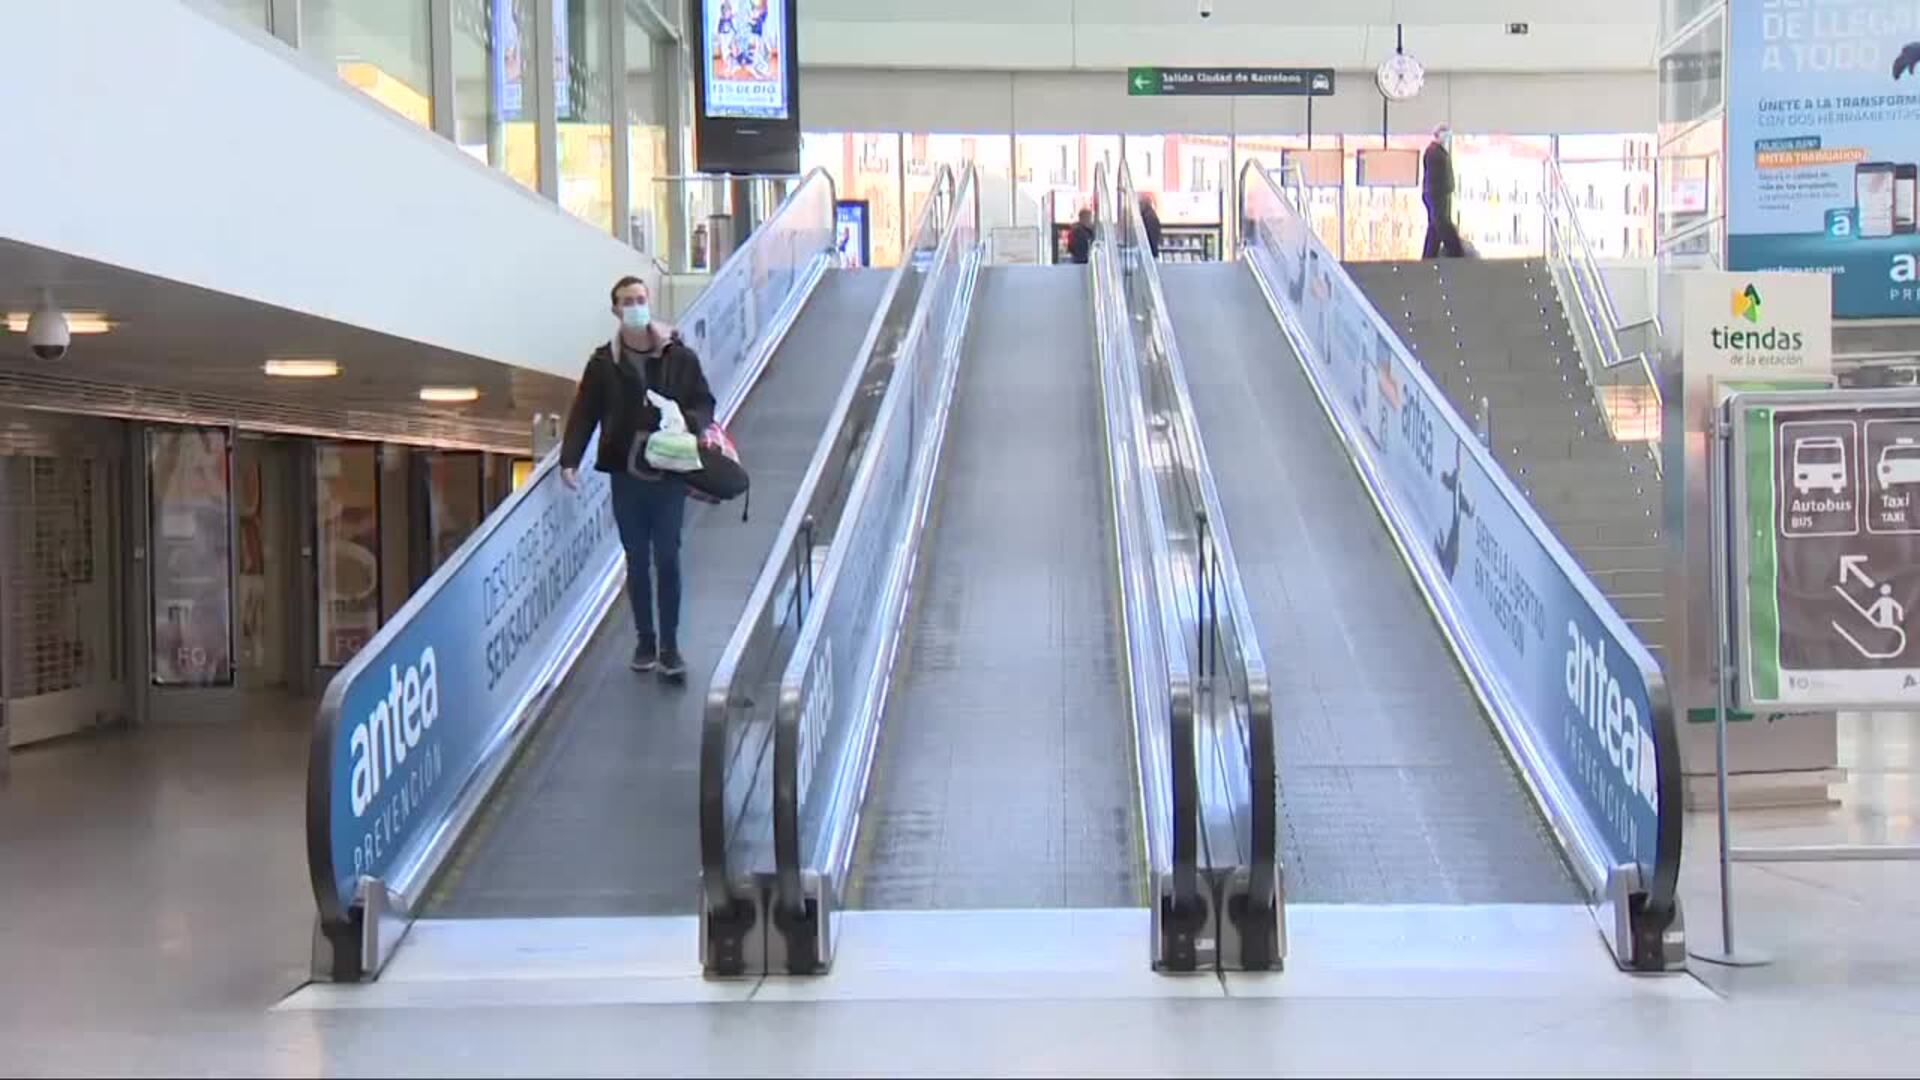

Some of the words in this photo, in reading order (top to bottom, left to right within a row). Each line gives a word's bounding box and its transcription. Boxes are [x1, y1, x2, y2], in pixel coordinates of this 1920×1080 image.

[1763, 11, 1802, 41] DE
[1814, 8, 1920, 39] LLEGA
[1785, 42, 1880, 73] TODO
[1162, 72, 1194, 83] Salida
[1197, 72, 1233, 83] Ciudad
[1236, 73, 1248, 83] de
[1251, 73, 1302, 83] Barcelona
[1890, 253, 1920, 282] a
[1711, 326, 1803, 350] tiendas
[1730, 354, 1744, 366] de
[1746, 353, 1756, 366] la
[1758, 353, 1803, 366] estación
[1401, 384, 1434, 477] antea
[1791, 498, 1852, 513] Autobus
[1881, 491, 1910, 508] Taxi
[1791, 515, 1813, 529] BUS
[1881, 511, 1906, 523] TAXI
[798, 636, 834, 806] antea
[1566, 619, 1640, 795] antea
[350, 645, 439, 819] antea
[1562, 724, 1638, 859] PREVENCIÓN
[353, 742, 443, 881] PREVENCIÓN
